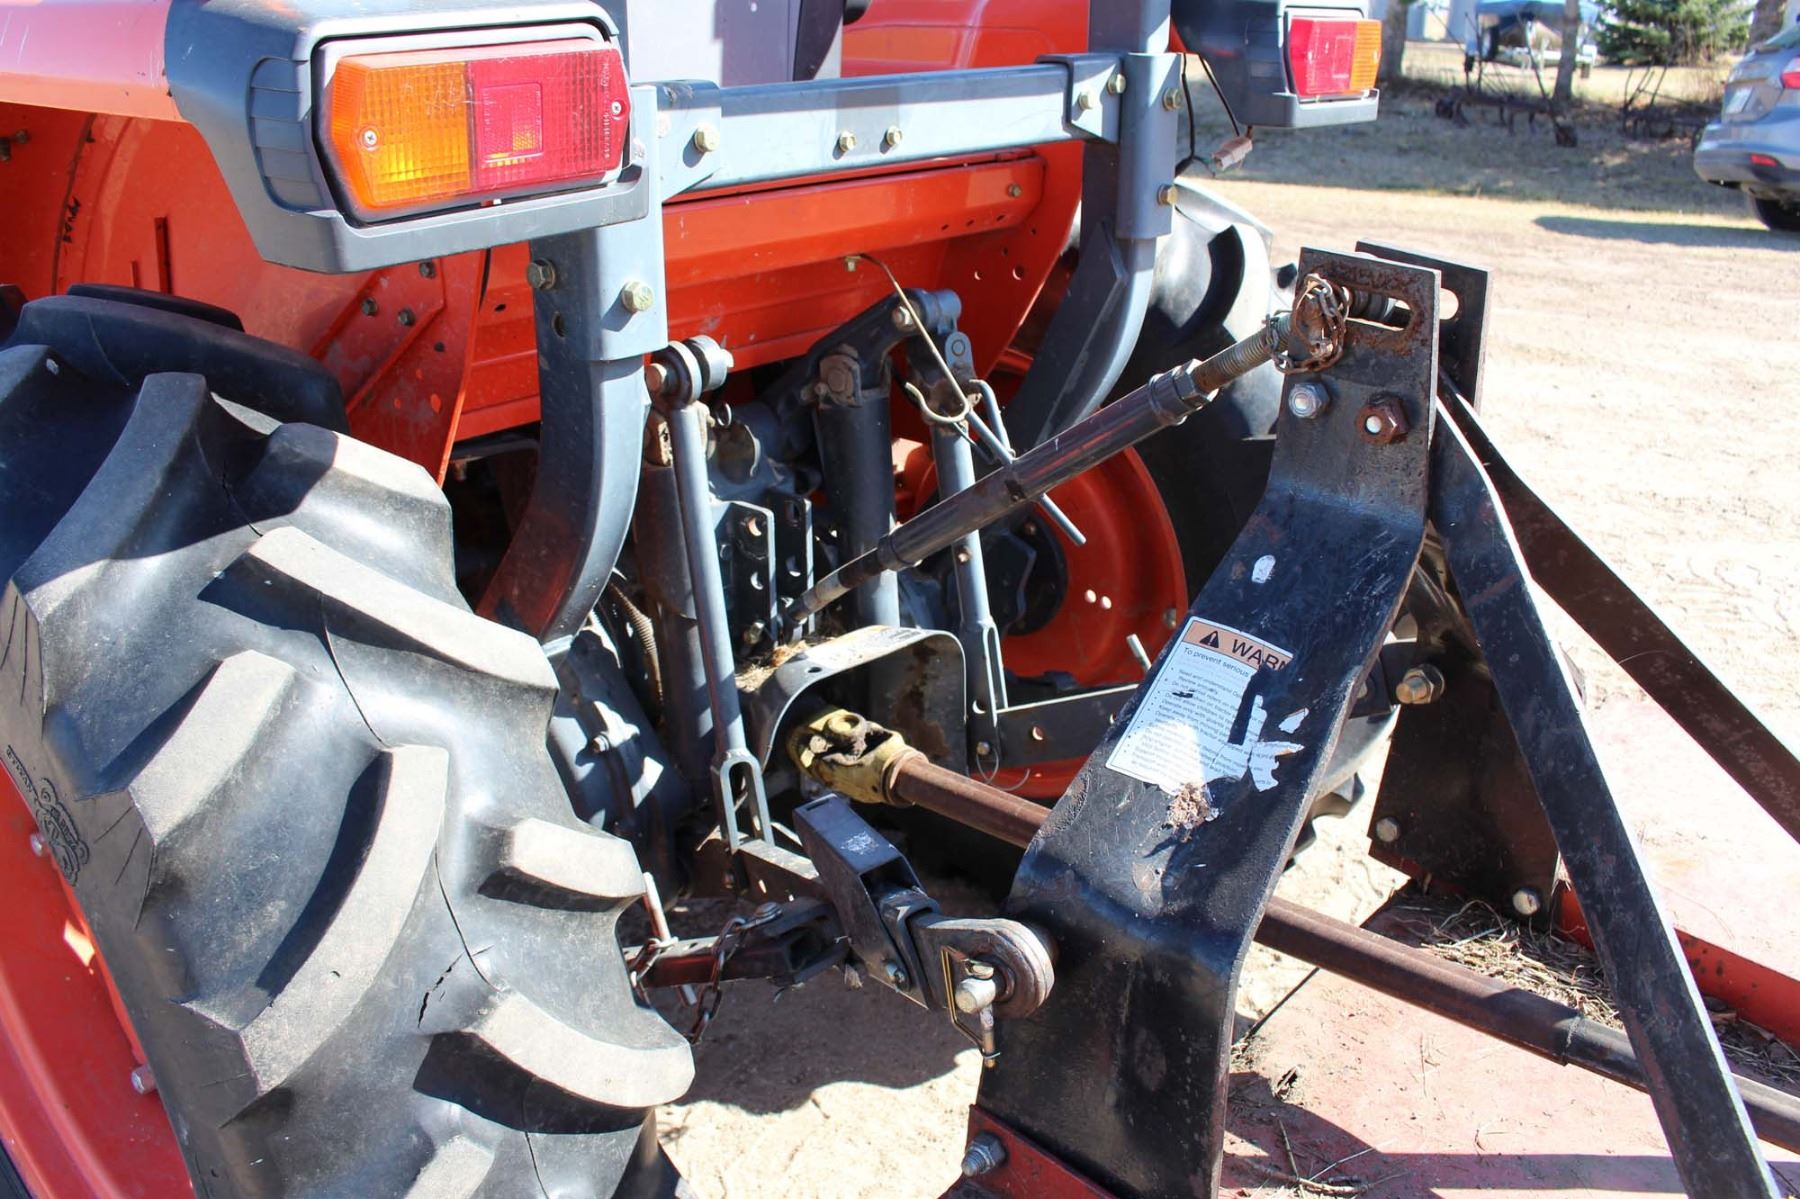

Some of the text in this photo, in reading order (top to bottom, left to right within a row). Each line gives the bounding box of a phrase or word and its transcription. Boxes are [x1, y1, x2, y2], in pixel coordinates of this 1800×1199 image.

[1184, 647, 1193, 655] To
[1193, 651, 1221, 665] prevent
[1223, 660, 1249, 678] serious
